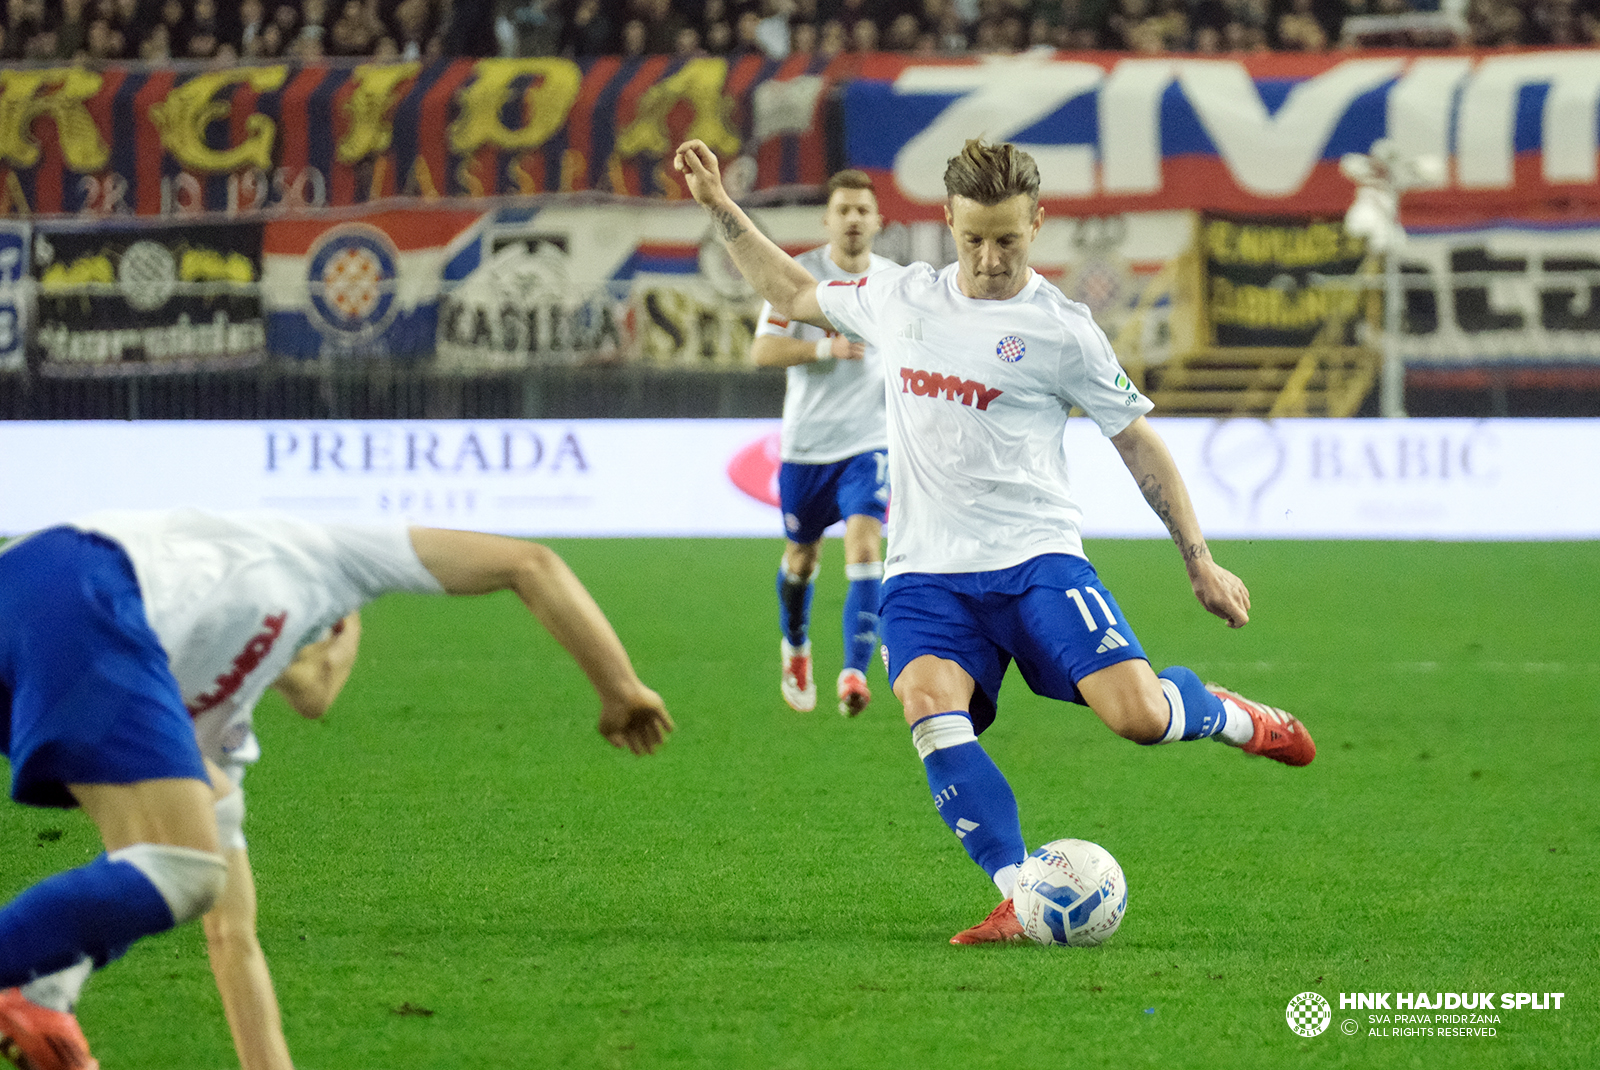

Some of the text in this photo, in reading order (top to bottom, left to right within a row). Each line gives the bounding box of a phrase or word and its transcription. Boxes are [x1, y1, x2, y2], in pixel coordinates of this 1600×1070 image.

[900, 367, 1004, 411] TOMMY
[1125, 393, 1138, 407] otp
[264, 428, 592, 473] PRERADA
[378, 490, 478, 512] SPLIT
[1065, 586, 1118, 633] 11
